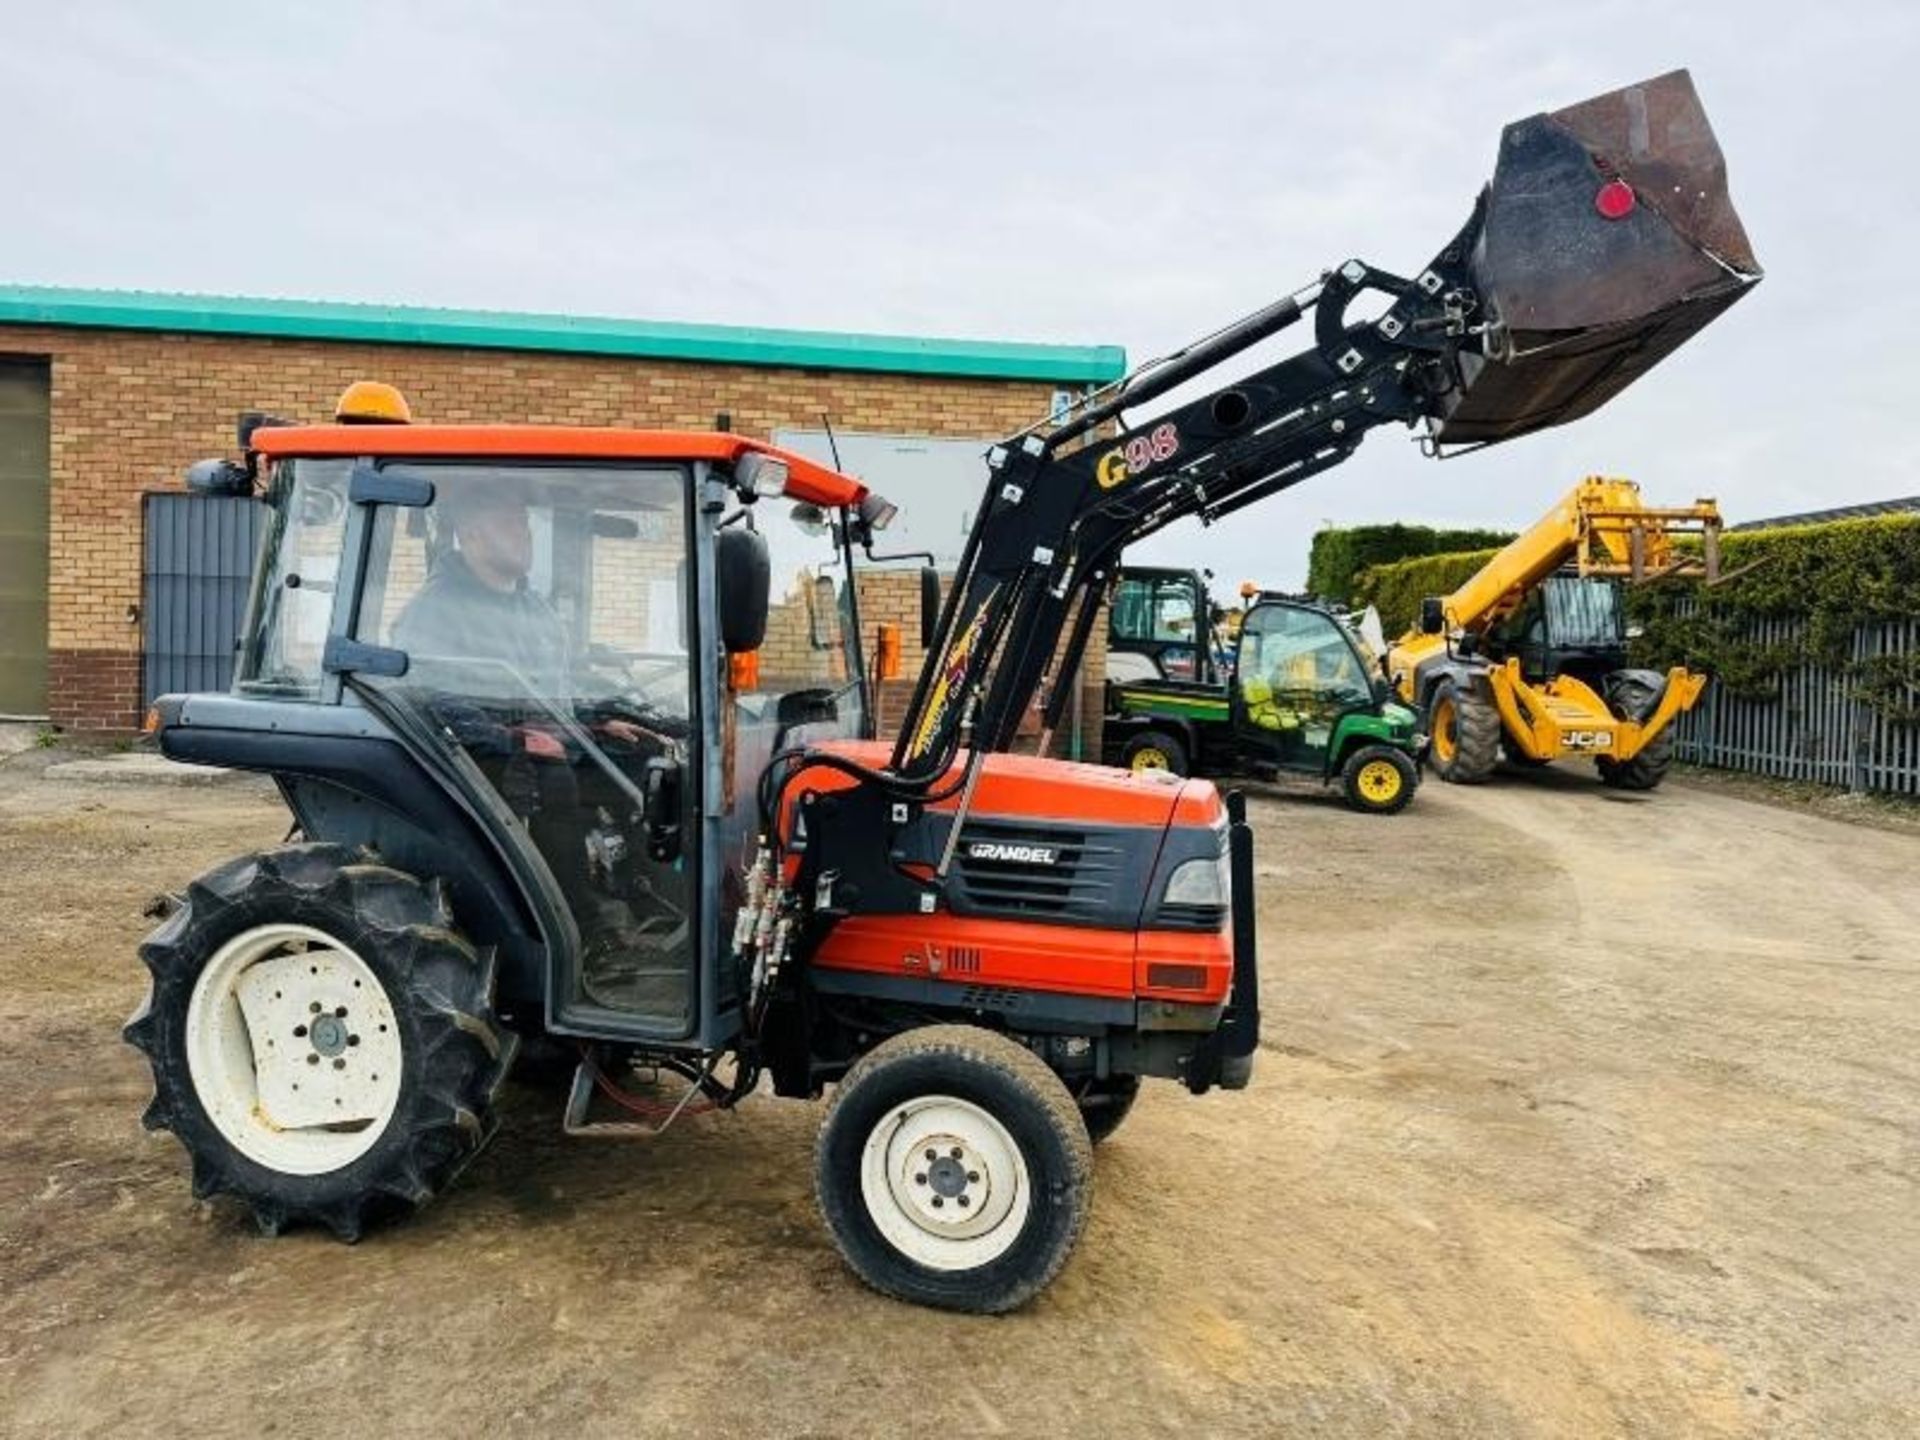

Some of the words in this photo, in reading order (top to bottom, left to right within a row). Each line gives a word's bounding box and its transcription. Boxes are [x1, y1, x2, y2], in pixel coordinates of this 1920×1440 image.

[1096, 423, 1179, 489] G98
[1561, 730, 1612, 747] JCB
[969, 843, 1055, 866] GRANDEL
